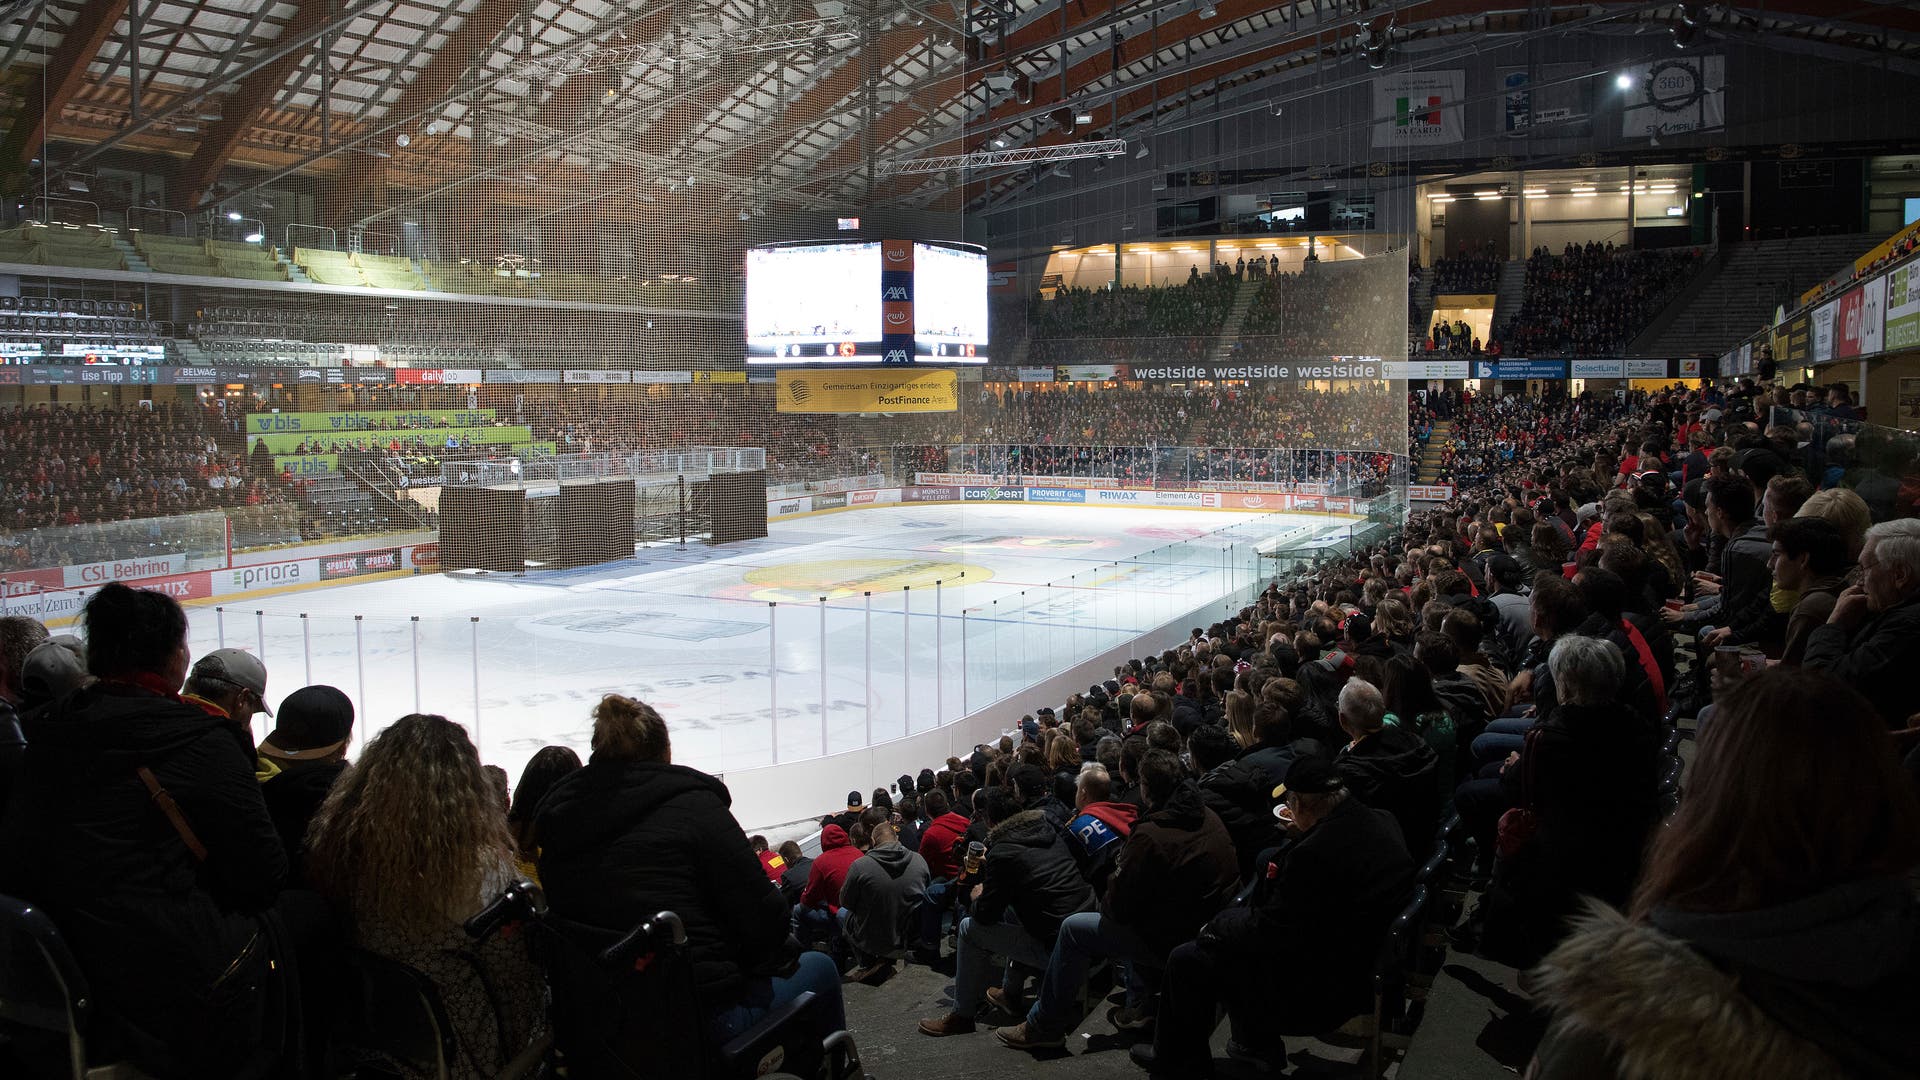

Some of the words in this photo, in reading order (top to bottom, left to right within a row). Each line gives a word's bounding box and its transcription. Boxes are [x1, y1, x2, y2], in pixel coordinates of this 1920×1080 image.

[883, 286, 908, 300] AXA
[883, 349, 909, 363] AXA
[183, 368, 217, 376] BELWAG
[1135, 365, 1206, 379] westside
[1213, 365, 1289, 379] westside
[1297, 364, 1375, 378] westside
[1575, 364, 1620, 372] SelectLine
[102, 370, 123, 383] Tipp
[822, 382, 868, 391] Gemeinsam
[870, 382, 919, 392] Einzigartiges
[878, 396, 931, 405] PostFinance
[275, 415, 301, 430] bls
[302, 457, 328, 472] bls
[1099, 491, 1137, 500] RIWAX
[1156, 491, 1187, 500] Element
[1188, 492, 1201, 500] AG
[82, 565, 110, 582] CSL
[114, 559, 170, 579] Behring
[244, 563, 300, 589] priora
